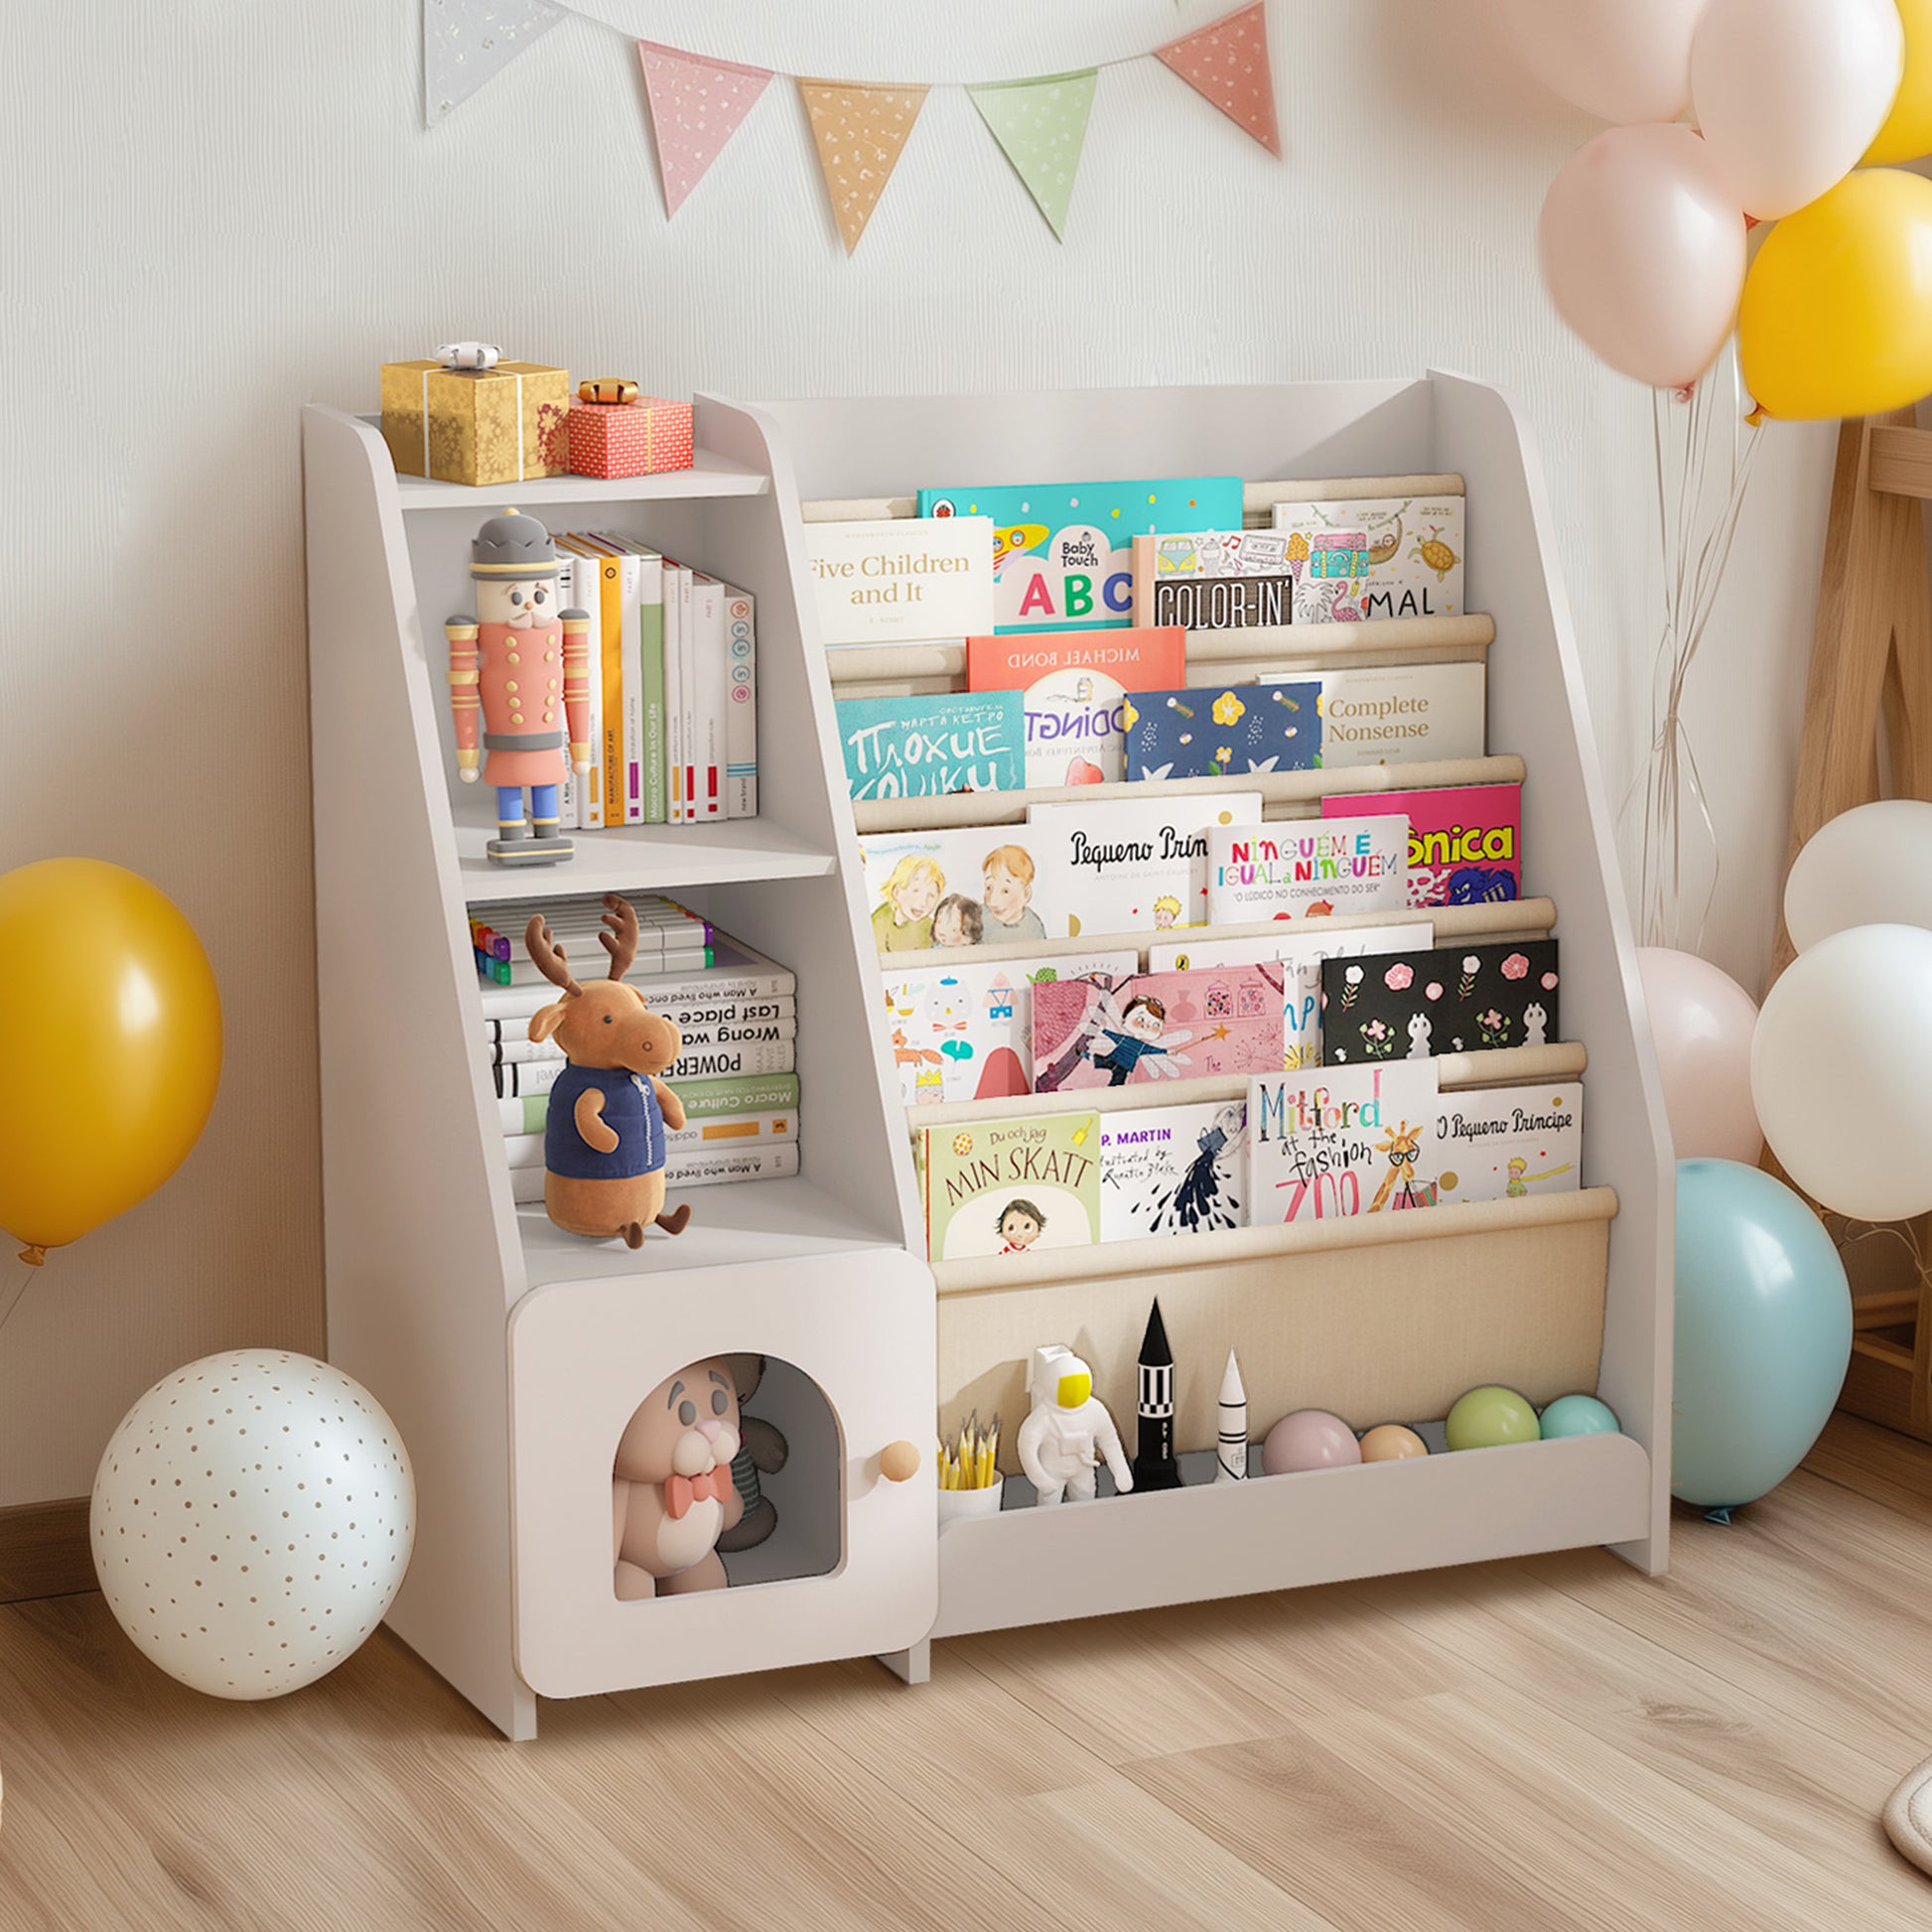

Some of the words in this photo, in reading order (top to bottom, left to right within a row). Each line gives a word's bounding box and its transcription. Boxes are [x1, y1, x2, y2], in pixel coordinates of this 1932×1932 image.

[1062, 541, 1095, 558] Baby
[860, 552, 971, 579] Children
[1060, 553, 1099, 568] Touch
[850, 583, 898, 605] and
[905, 581, 923, 603] It
[648, 701, 657, 719] Life
[953, 711, 1005, 726] КЕТРО
[1328, 695, 1430, 723] Complete
[648, 721, 657, 739] Our
[1327, 721, 1430, 744] Nonsense
[648, 752, 658, 785] Culture
[649, 787, 658, 820] Macro
[1070, 830, 1154, 872] Pequeno
[1355, 829, 1372, 855] É
[1217, 861, 1282, 887] IGUAL
[1275, 889, 1288, 899] NO
[1351, 884, 1364, 894] DO
[671, 994, 696, 1004] lived
[698, 991, 721, 1001] who
[723, 989, 748, 998] Man
[749, 988, 758, 997] A
[679, 1005, 736, 1025] place
[742, 1006, 779, 1022] Last
[717, 1027, 780, 1044] Wrong
[1203, 1054, 1223, 1073] The
[687, 1095, 740, 1110] Culture
[745, 1091, 792, 1106] Macro
[1258, 1068, 1384, 1143] Mitford
[989, 1131, 1006, 1145] Du
[1007, 1128, 1027, 1142] och
[1025, 1126, 1047, 1145] jag
[1451, 1113, 1509, 1142] Pequeno
[1101, 1134, 1112, 1147] P.
[1116, 1128, 1173, 1146] MARTIN
[1281, 1137, 1300, 1157] at
[1308, 1128, 1337, 1149] the
[703, 1167, 726, 1176] who
[727, 1164, 752, 1173] Man
[753, 1164, 761, 1173] A
[1289, 1138, 1374, 1187] fashion
[675, 1169, 700, 1179] lived
[944, 1154, 1001, 1208] MIN
[1008, 1146, 1094, 1189] SKATT
[1275, 1170, 1360, 1222] ZOO
